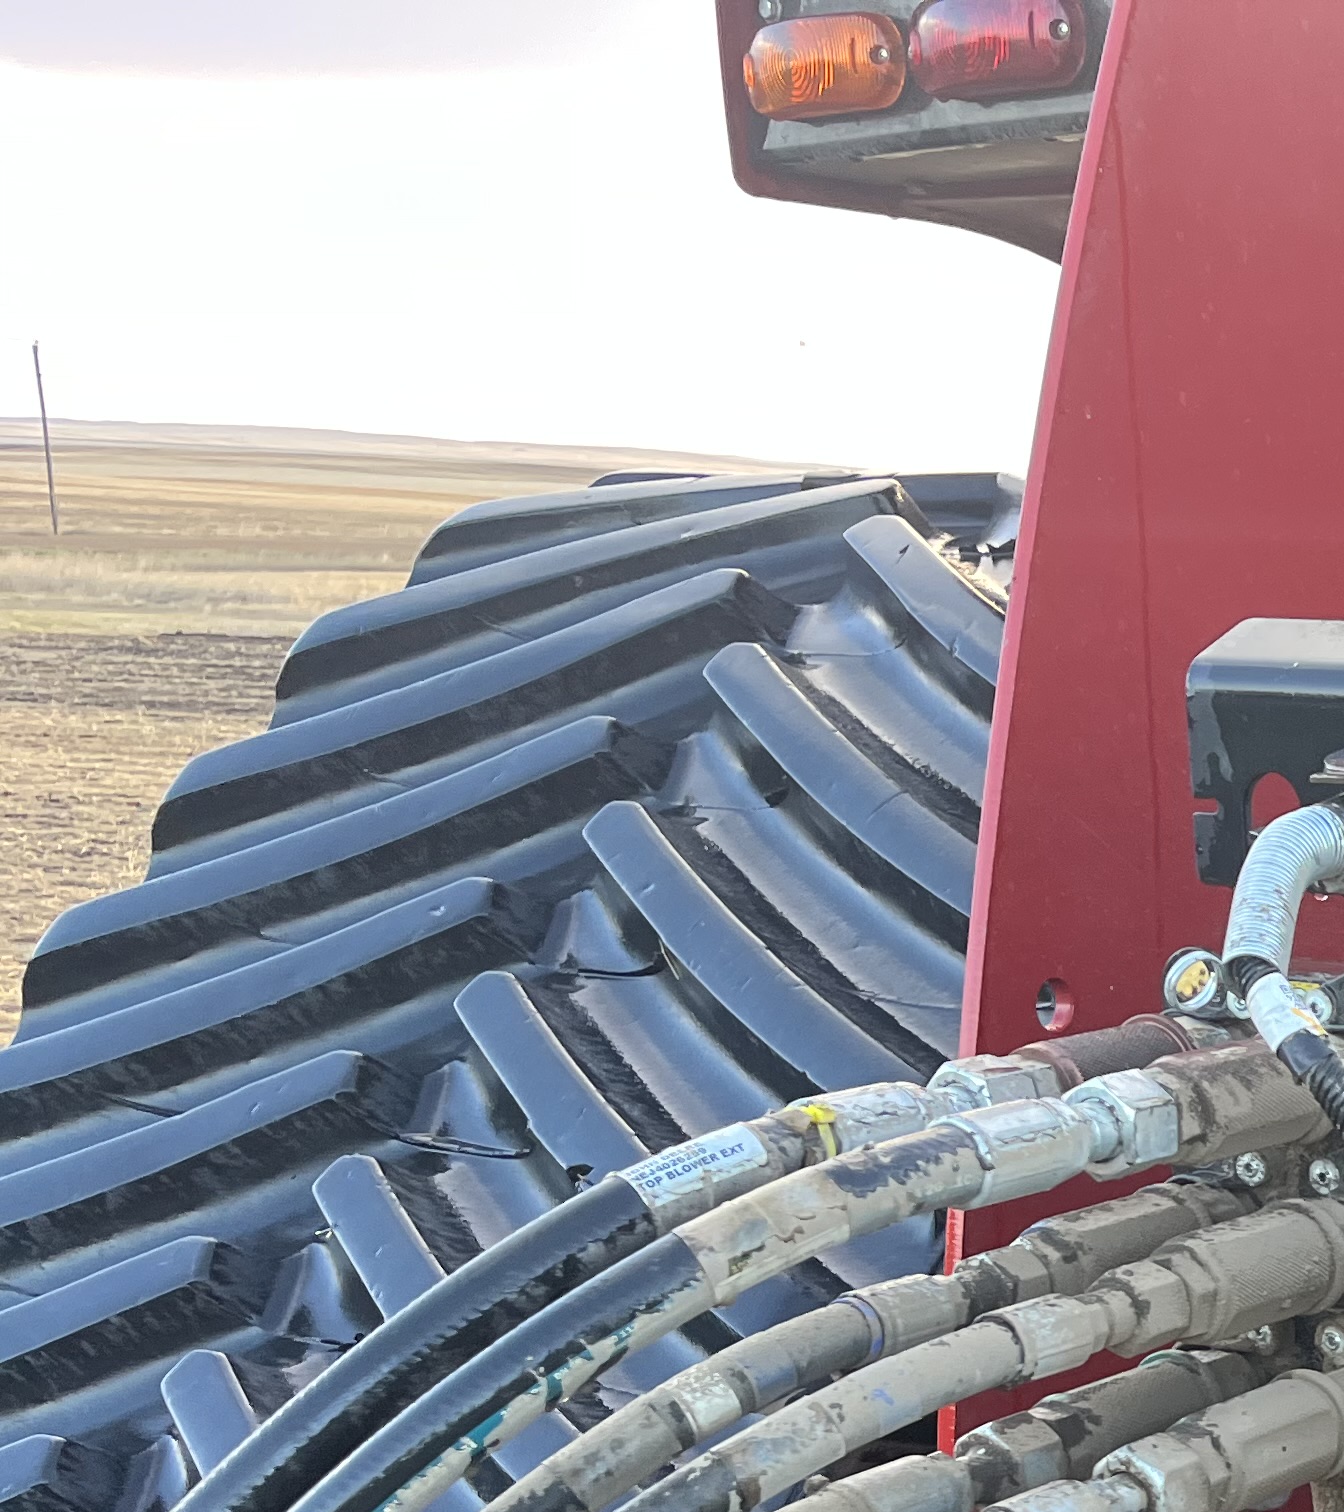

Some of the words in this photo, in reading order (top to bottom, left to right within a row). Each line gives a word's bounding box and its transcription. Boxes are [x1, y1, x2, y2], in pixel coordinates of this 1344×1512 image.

[638, 1176, 664, 1192] TOP
[668, 1153, 720, 1180] BLOWER
[721, 1142, 745, 1159] EXT
